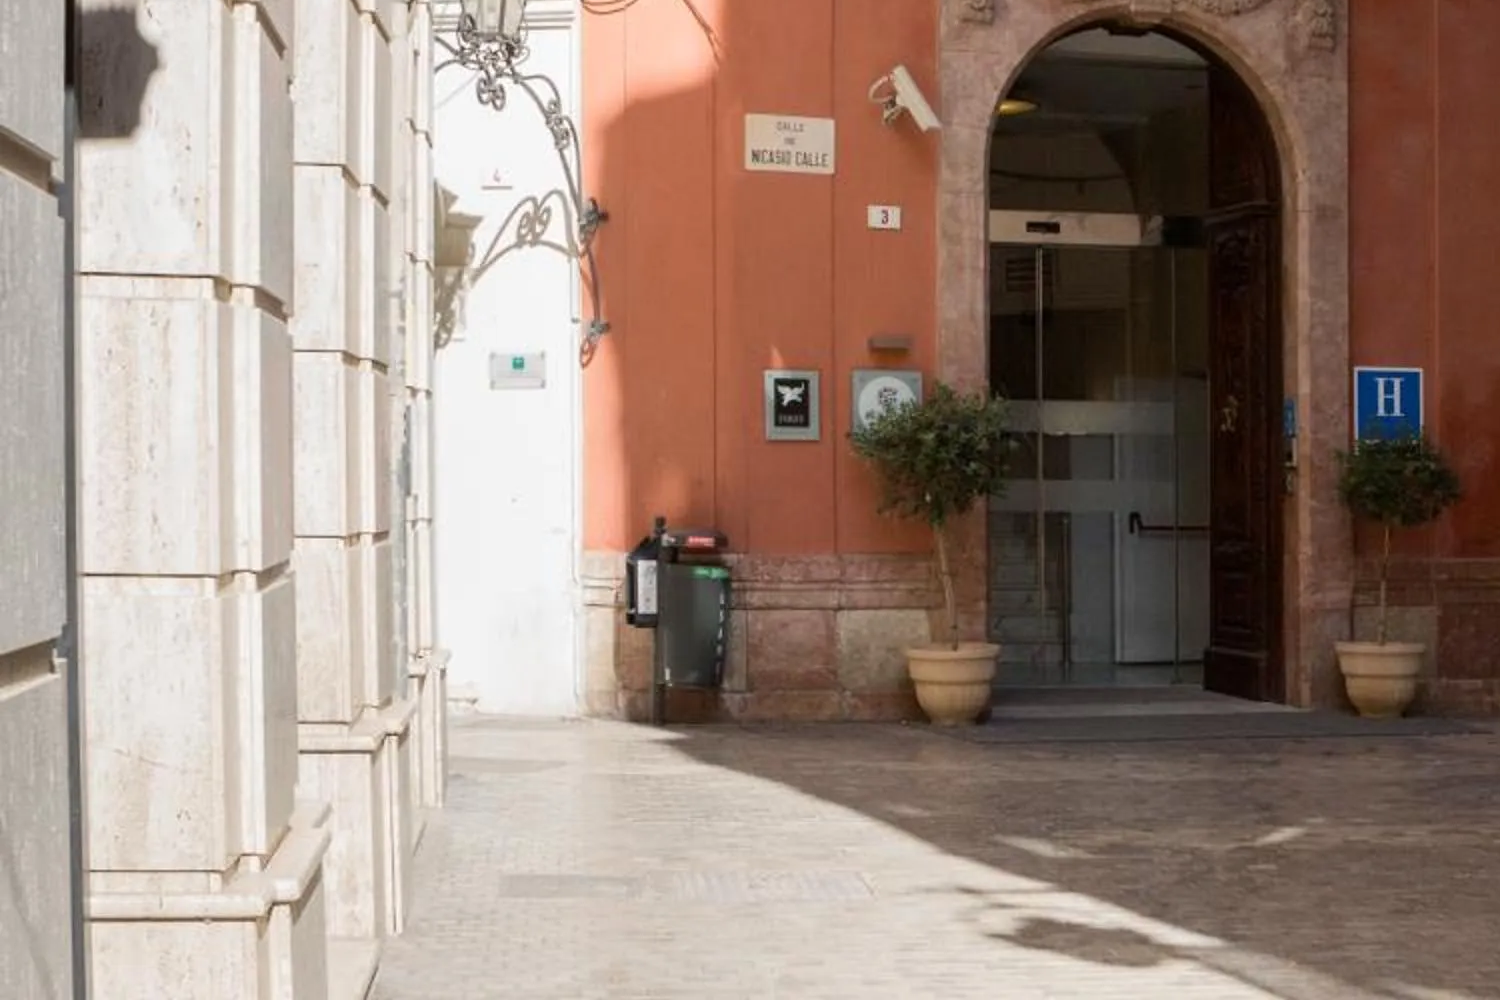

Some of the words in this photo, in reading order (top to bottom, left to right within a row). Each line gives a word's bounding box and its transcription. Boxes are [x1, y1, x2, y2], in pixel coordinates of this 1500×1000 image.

[795, 151, 829, 168] CALLE
[881, 209, 889, 225] 3
[1374, 377, 1405, 417] H
